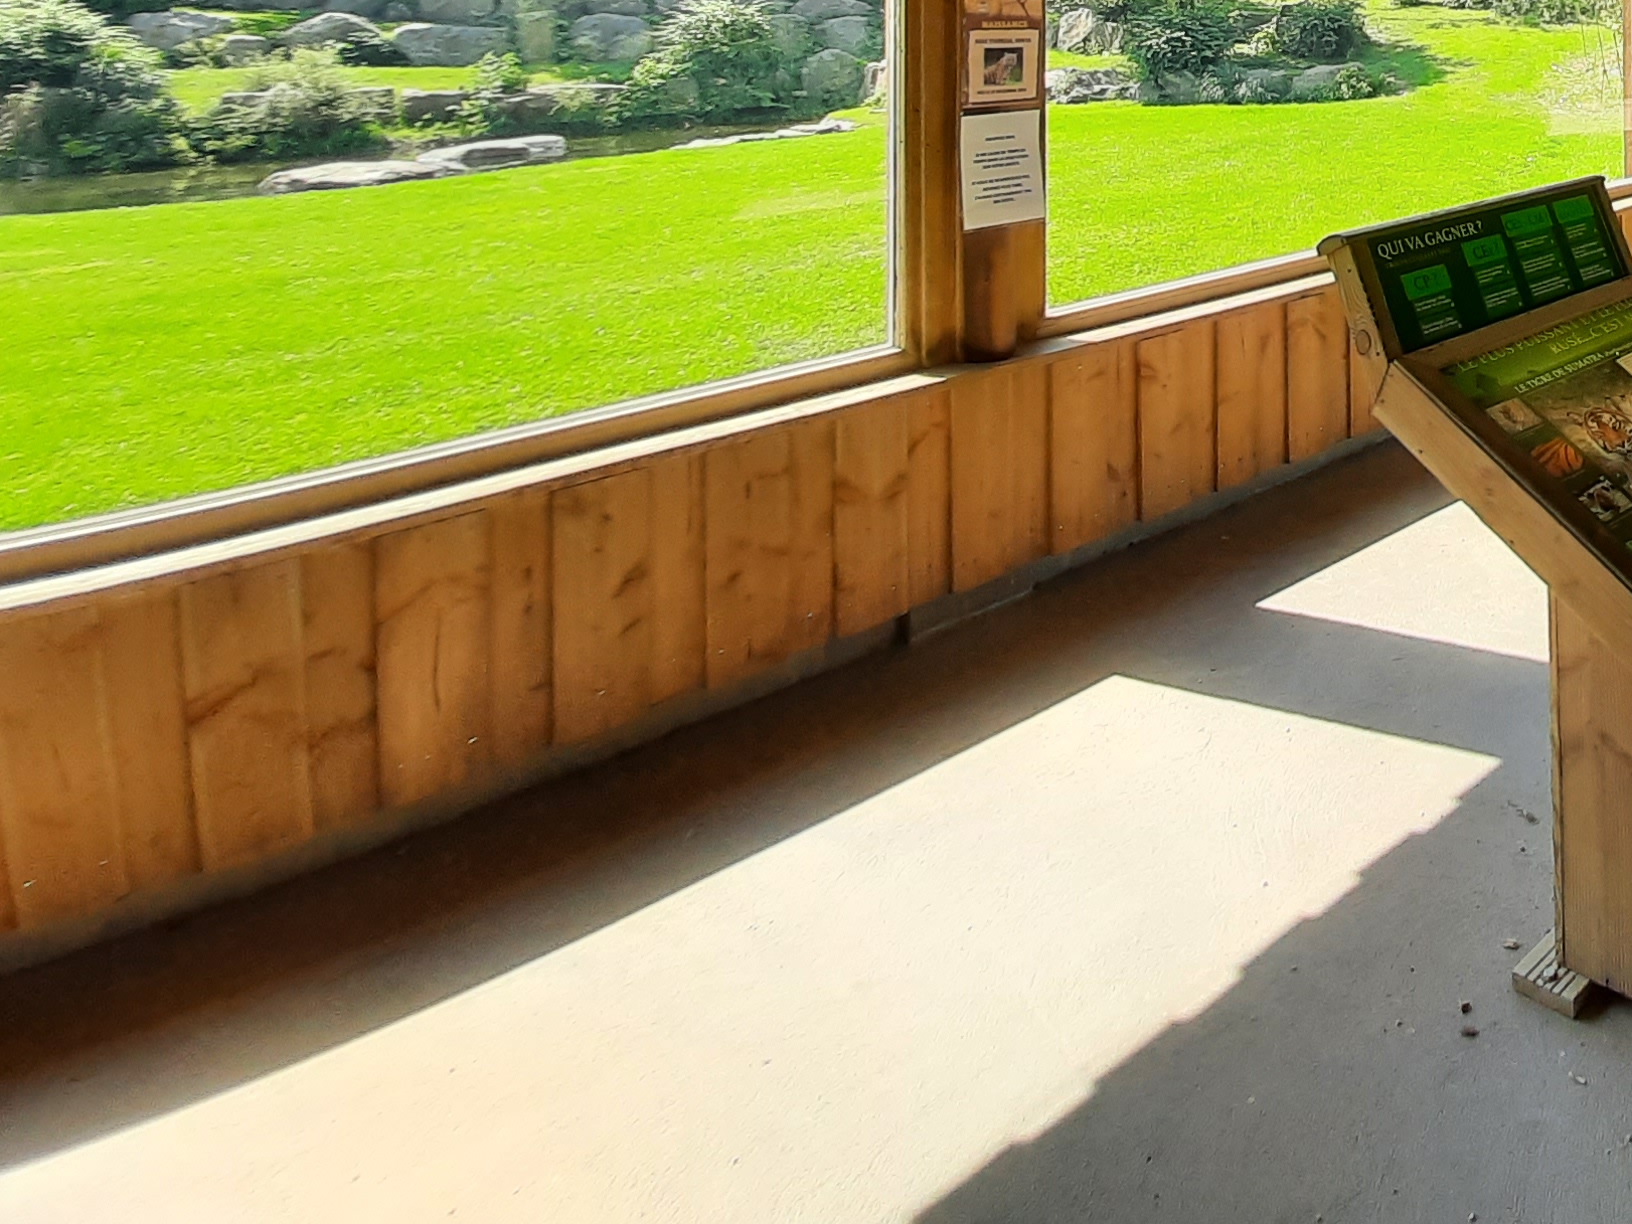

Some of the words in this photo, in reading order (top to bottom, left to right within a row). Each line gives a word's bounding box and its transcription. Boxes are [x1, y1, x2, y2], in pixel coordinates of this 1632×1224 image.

[1377, 239, 1405, 260] QUI
[1404, 235, 1425, 251] VA
[1424, 222, 1479, 246] GAGNER
[1478, 344, 1516, 364] PLUS
[1515, 319, 1580, 351] PUISSANT
[1513, 383, 1527, 395] LE
[1525, 373, 1555, 390] TIGRE
[1553, 367, 1566, 379] DE
[1565, 352, 1606, 375] SUMATRA
